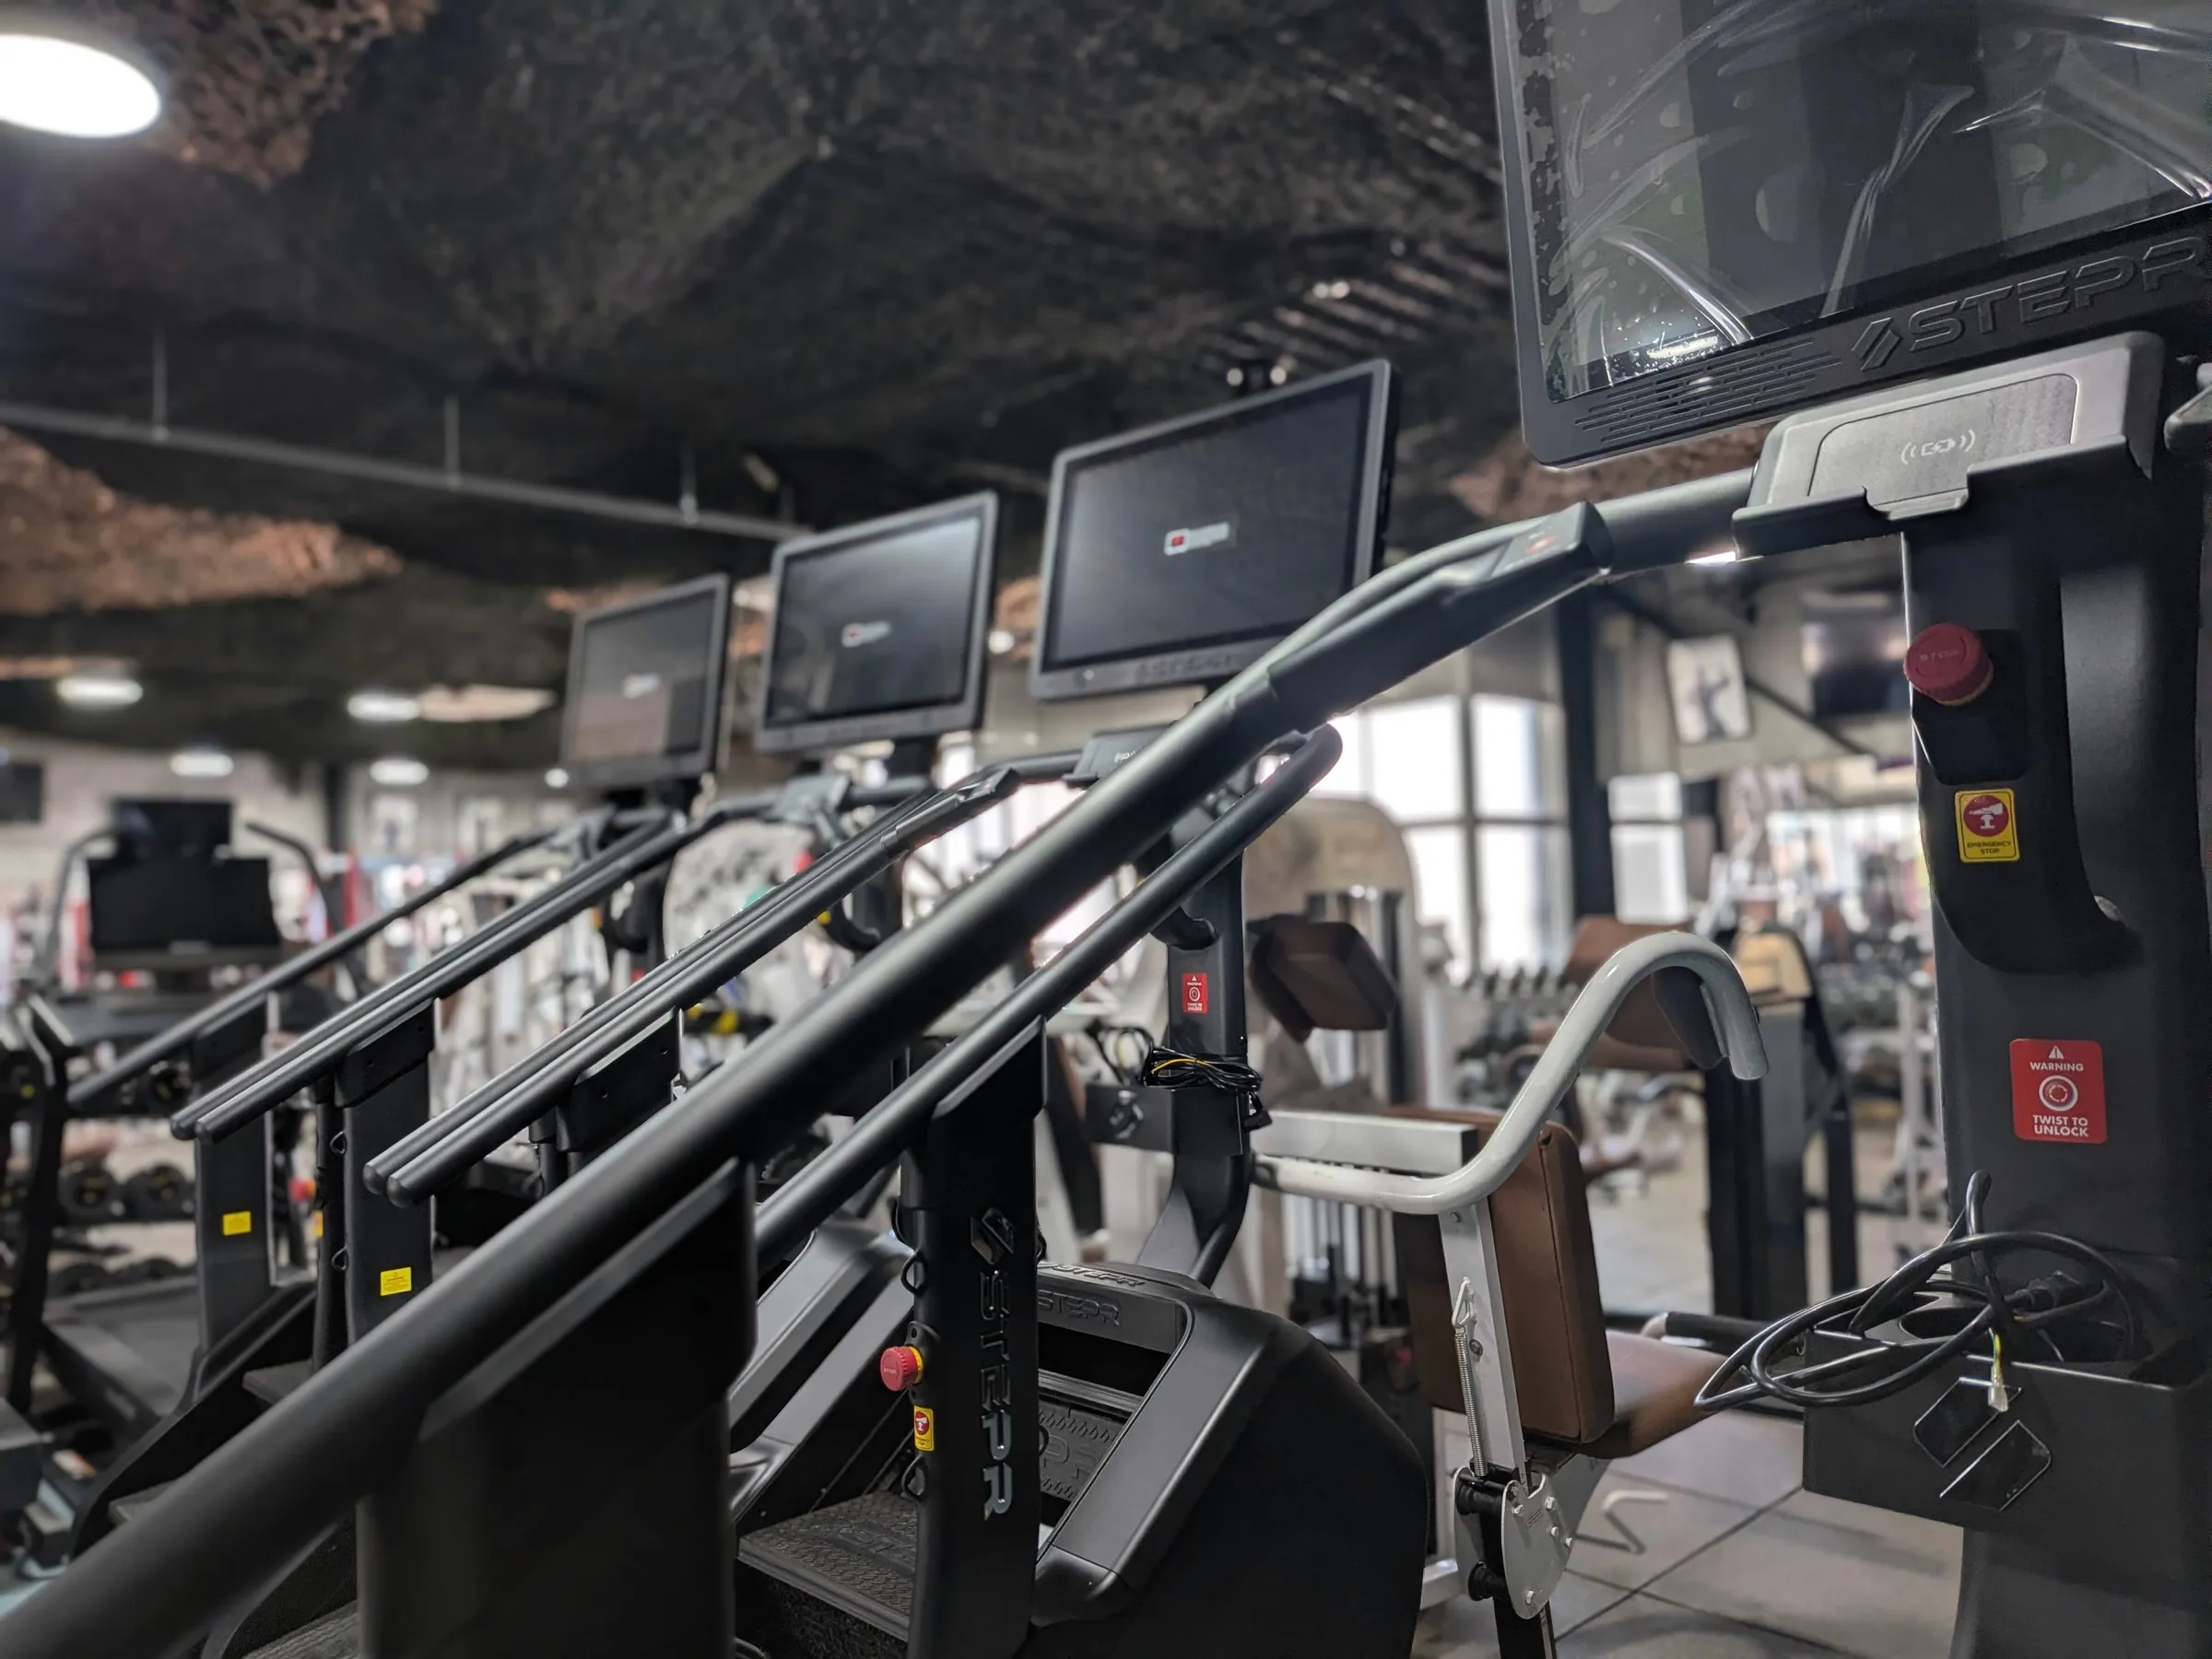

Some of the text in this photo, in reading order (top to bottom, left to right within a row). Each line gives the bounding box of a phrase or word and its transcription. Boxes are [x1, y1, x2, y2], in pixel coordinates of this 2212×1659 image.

[2030, 1062, 2084, 1072] WARNING
[2032, 1114, 2088, 1127] TWIST TO
[2033, 1124, 2089, 1137] UNLOCK
[981, 1268, 1012, 1521] STEPR
